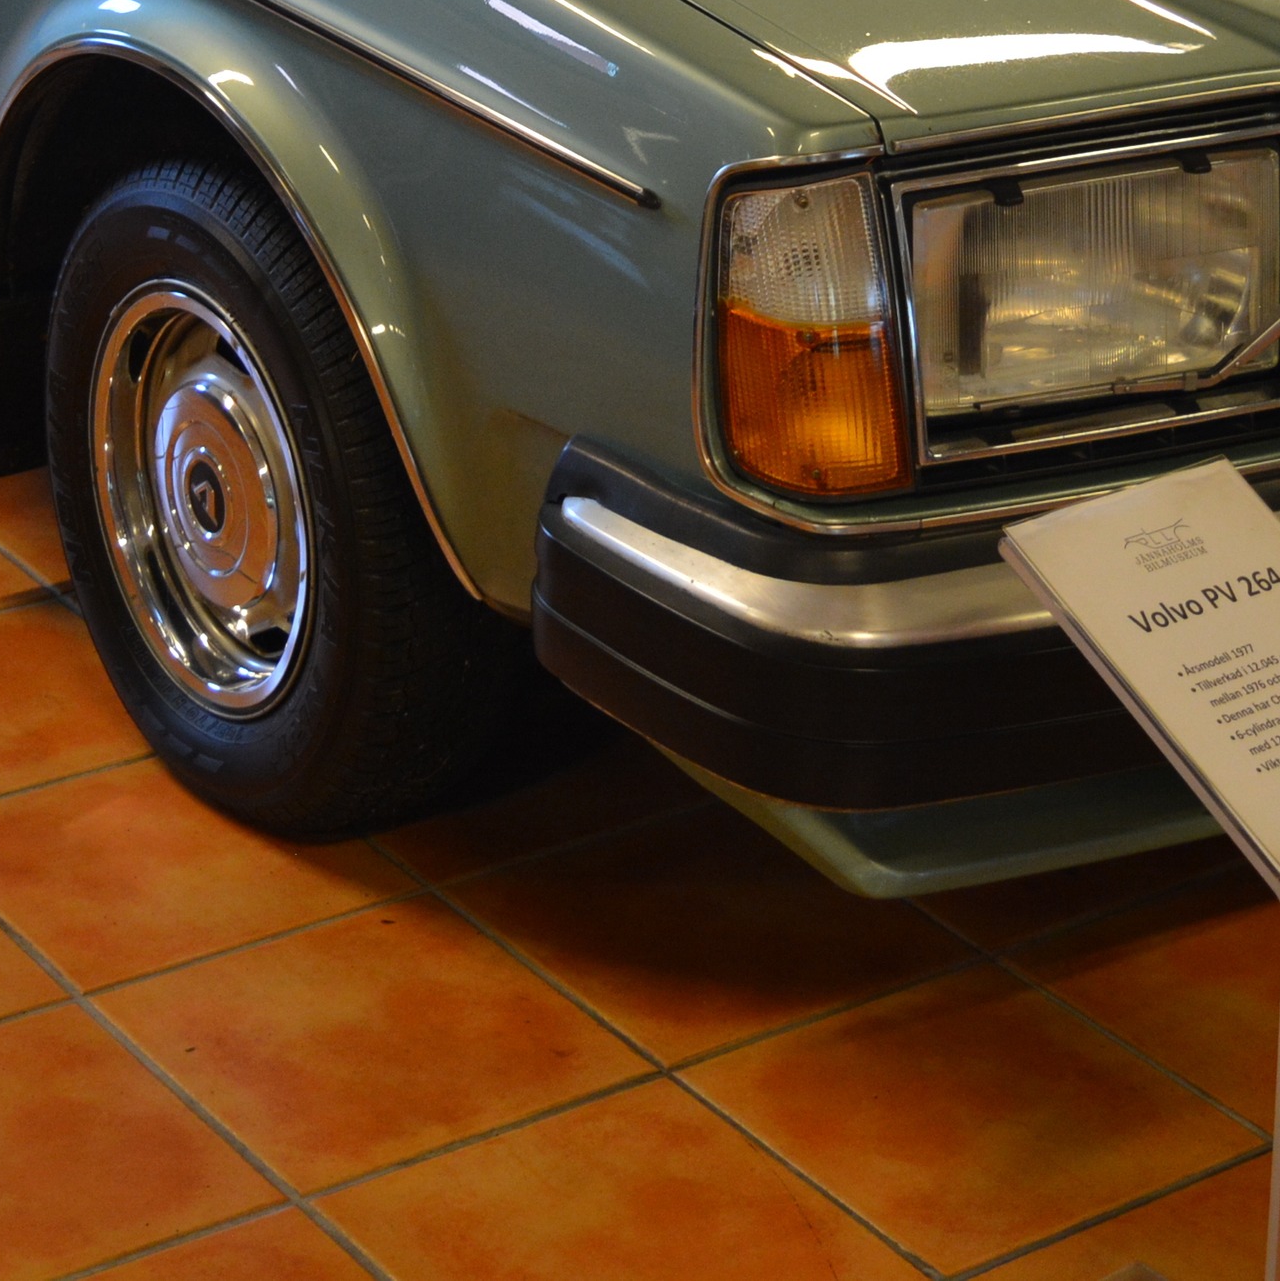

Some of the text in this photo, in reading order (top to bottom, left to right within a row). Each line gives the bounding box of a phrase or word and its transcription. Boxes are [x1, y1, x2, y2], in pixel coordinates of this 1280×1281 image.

[1144, 546, 1208, 573] BILMUSEUM
[1127, 599, 1204, 633] Volvo
[1201, 581, 1238, 609] PV
[1183, 643, 1255, 676] Årsmodell 1977
[1195, 668, 1243, 692] Tillverkad
[1248, 655, 1279, 673] 12.045
[1210, 687, 1243, 708] mellan
[1242, 679, 1267, 695] 1976
[1222, 705, 1255, 724] Denna
[1254, 699, 1270, 712] har
[1249, 739, 1271, 756] med
